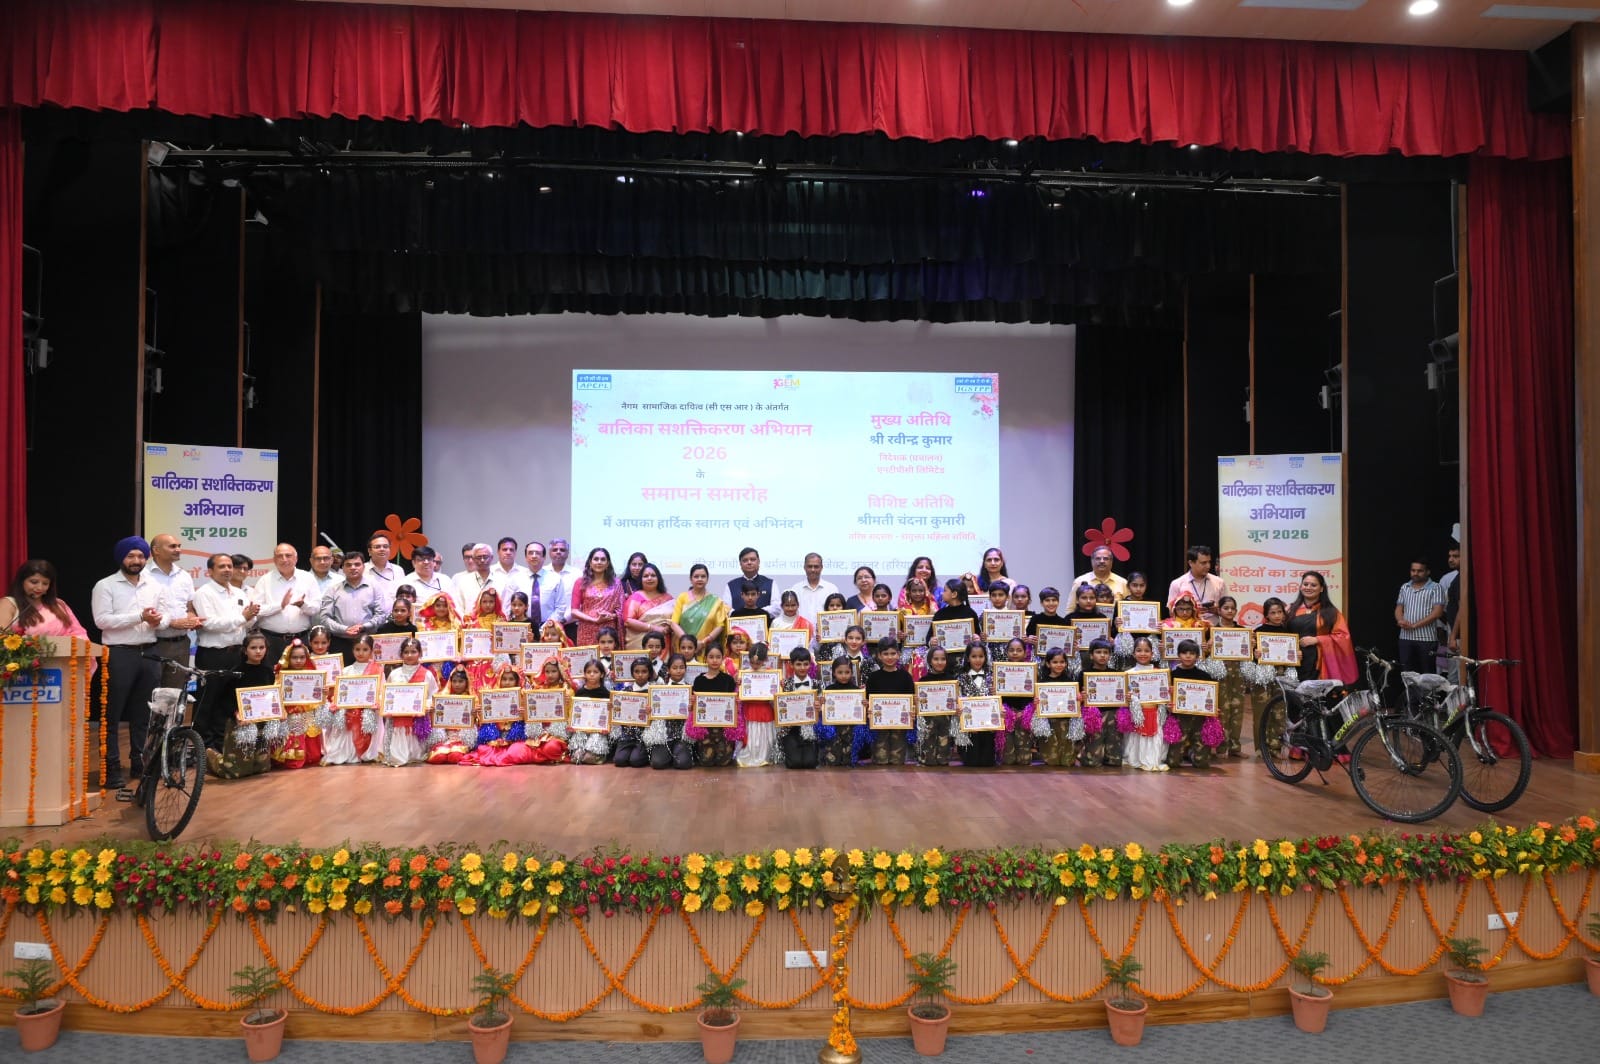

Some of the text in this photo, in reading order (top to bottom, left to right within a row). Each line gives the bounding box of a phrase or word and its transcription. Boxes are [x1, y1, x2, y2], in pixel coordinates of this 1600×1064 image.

[579, 382, 609, 390] APCPL
[642, 402, 677, 411] सामाजिक
[720, 403, 732, 411] एस
[755, 402, 764, 411] के
[598, 418, 813, 437] बालिका सशक्तिकरण अभियान
[870, 412, 952, 430] मुख्य अतिथि
[869, 432, 953, 448] श्री रवीन्द्र कुमार
[682, 446, 728, 460] 2026
[695, 468, 706, 480] के
[151, 472, 274, 493] बालिका सशक्तिकरण
[1222, 479, 1336, 497] बालिका सशक्तिकरण
[640, 483, 769, 504] समापन समारोह
[183, 498, 245, 517] अभियान
[867, 494, 955, 509] विशिष्ट अतिथि
[1249, 503, 1306, 520] अभियान
[602, 516, 804, 531] में आपका हार्दिक स्वागत एवं अभिनंदन
[857, 512, 966, 528] श्रीमती चंदना कुमारी
[180, 526, 248, 541] जून 2026
[1247, 529, 1310, 543] जून 2026
[1268, 569, 1287, 578] का
[1229, 582, 1250, 593] देश
[1254, 584, 1272, 593] का
